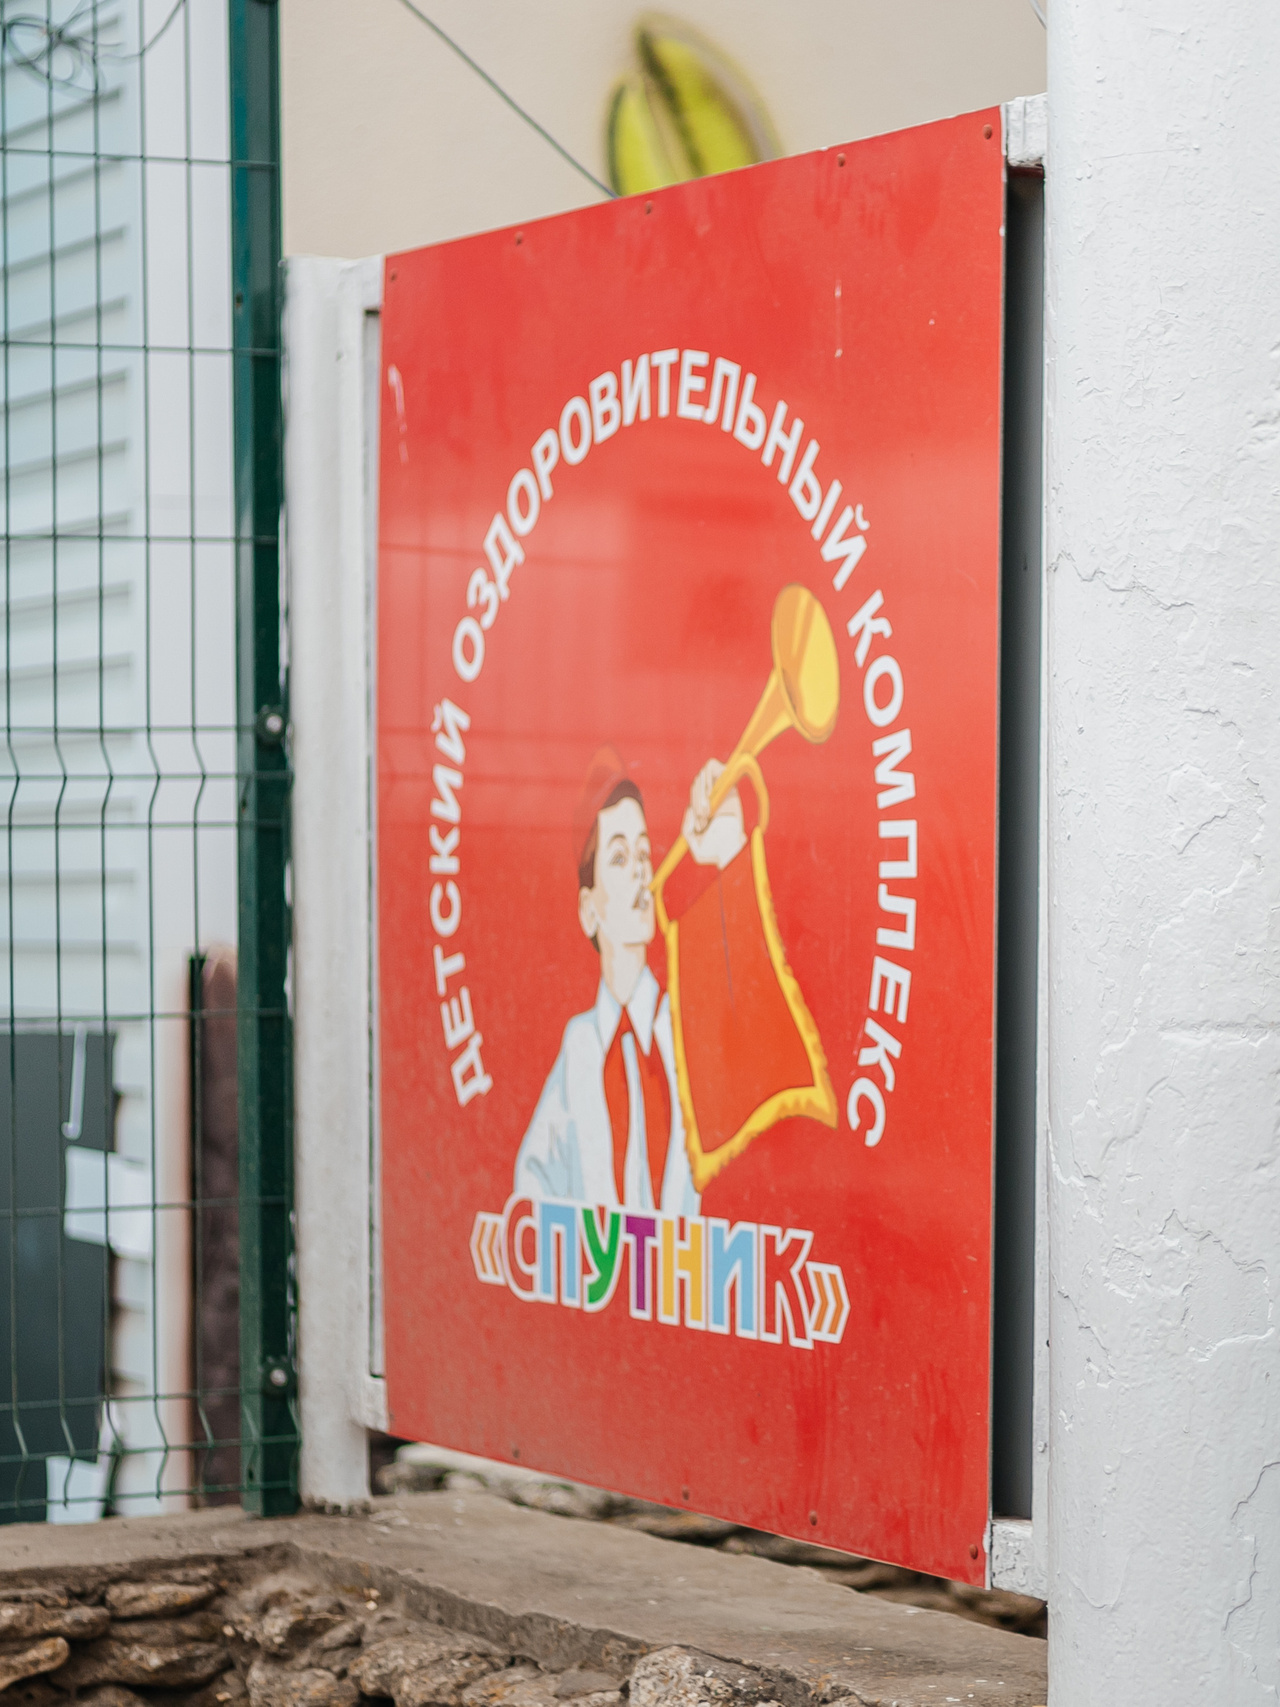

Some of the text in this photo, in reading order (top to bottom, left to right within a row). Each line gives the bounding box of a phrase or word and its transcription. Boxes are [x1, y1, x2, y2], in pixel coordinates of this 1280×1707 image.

[429, 348, 918, 1148] ДЕТСКИЙ ОЗДОРОВИТЕЛЬНЫЙ КОМПЛЕКС
